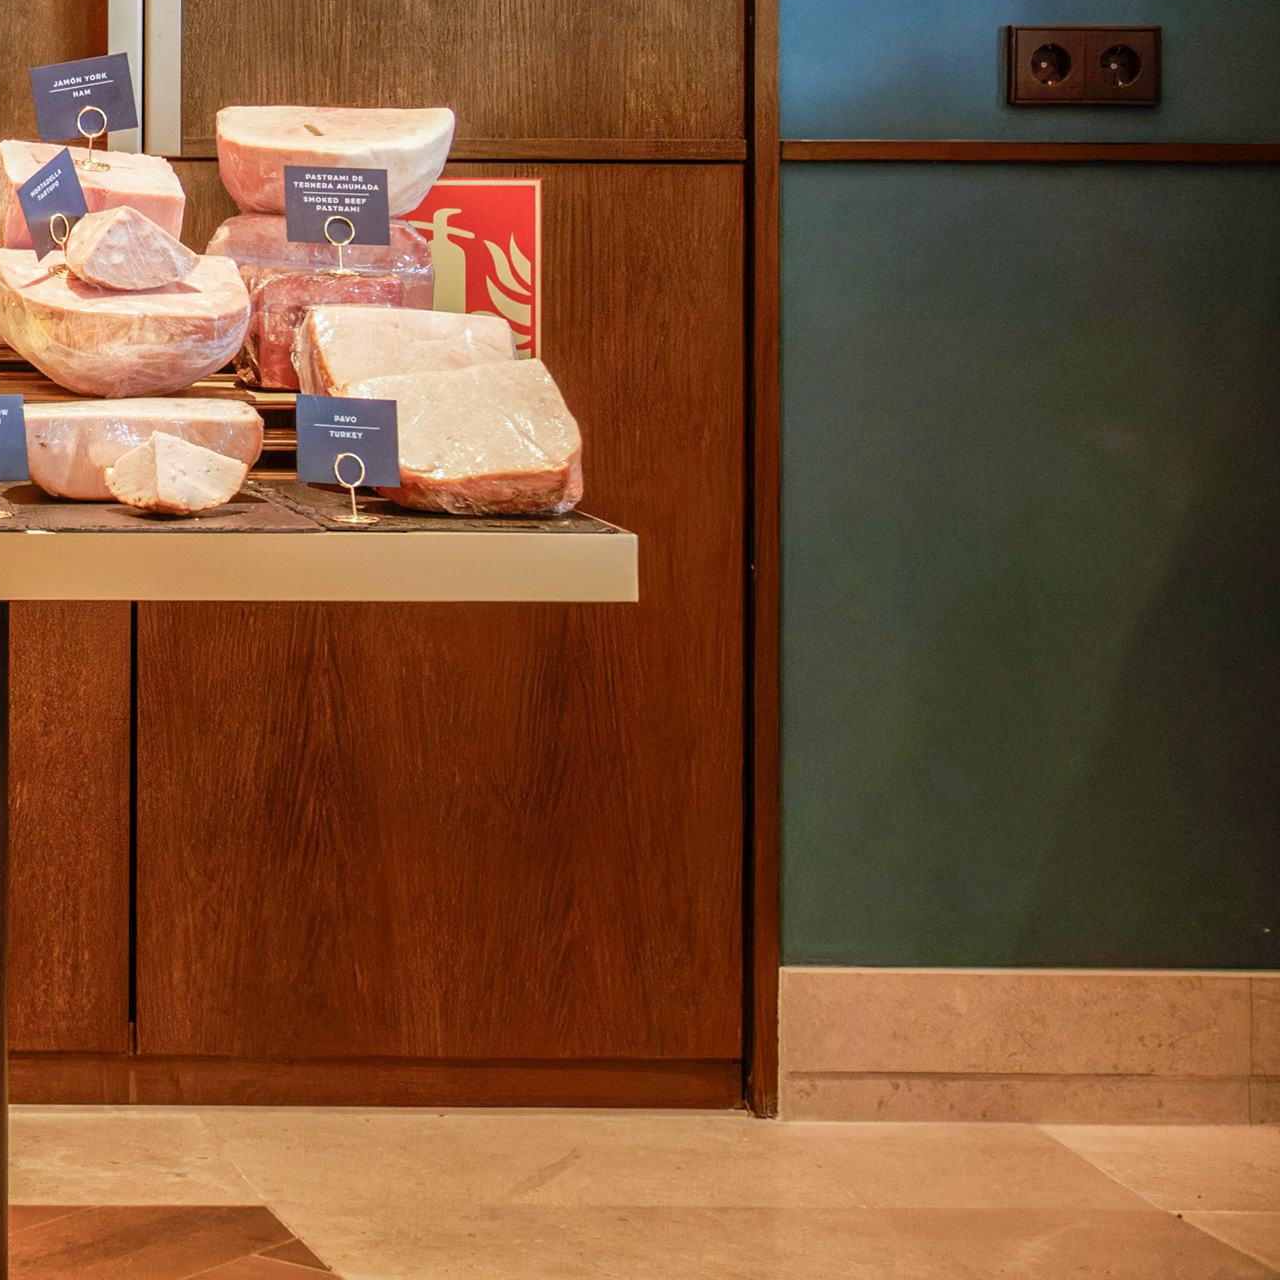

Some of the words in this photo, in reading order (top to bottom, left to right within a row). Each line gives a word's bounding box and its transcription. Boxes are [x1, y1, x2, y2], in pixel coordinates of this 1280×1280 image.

[53, 75, 82, 88] JAMÓN
[84, 72, 108, 82] YORK
[72, 88, 91, 98] HAM
[305, 173, 349, 182] PASTRAMI
[293, 181, 334, 189] TERNERA
[336, 183, 379, 191] AHUMADA
[303, 196, 339, 204] SMOKED
[344, 197, 367, 205] BEEF
[316, 205, 360, 213] PASTRAMI
[334, 415, 357, 423] PAVO
[329, 430, 363, 439] TURKEY
